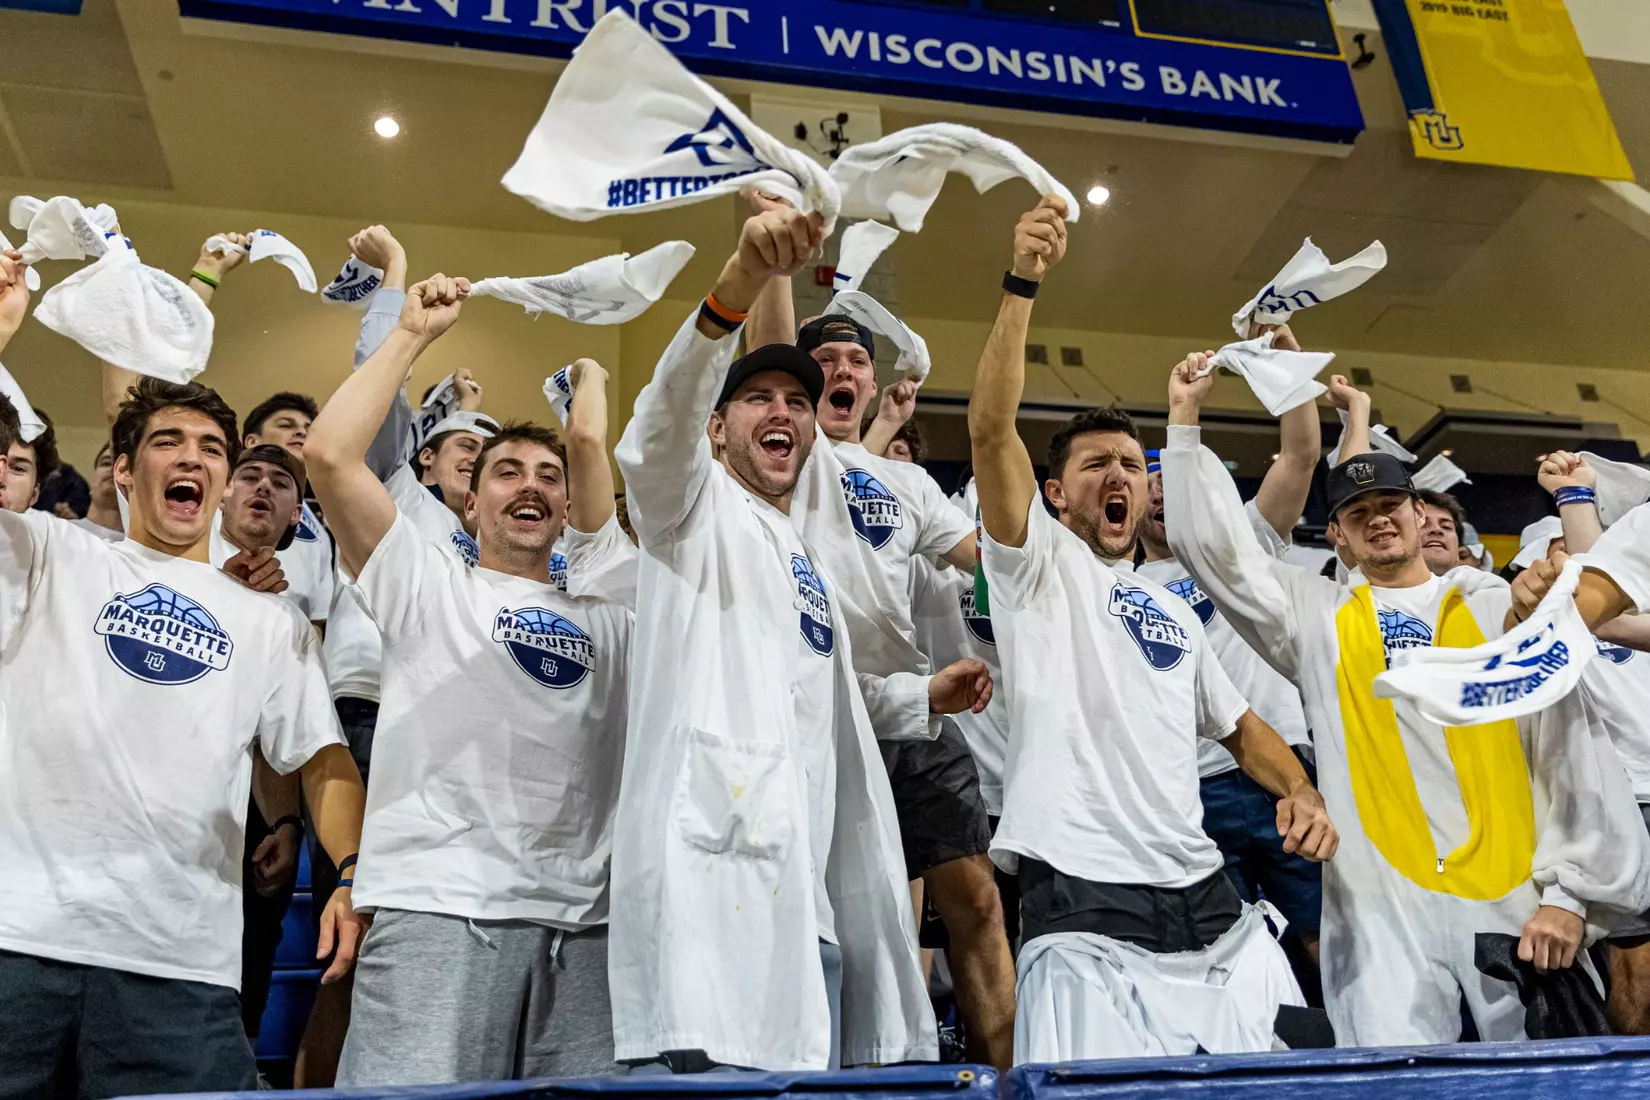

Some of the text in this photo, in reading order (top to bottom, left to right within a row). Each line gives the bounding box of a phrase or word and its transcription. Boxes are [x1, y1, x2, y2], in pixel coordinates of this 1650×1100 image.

[1451, 5, 1475, 17] BIG
[1476, 8, 1509, 22] EAST
[814, 24, 1146, 91] WISCONSIN'S
[103, 604, 229, 656] MARQUETTE
[107, 622, 214, 664] BASKETBALL
[144, 650, 166, 672] MU
[540, 657, 558, 678] MU
